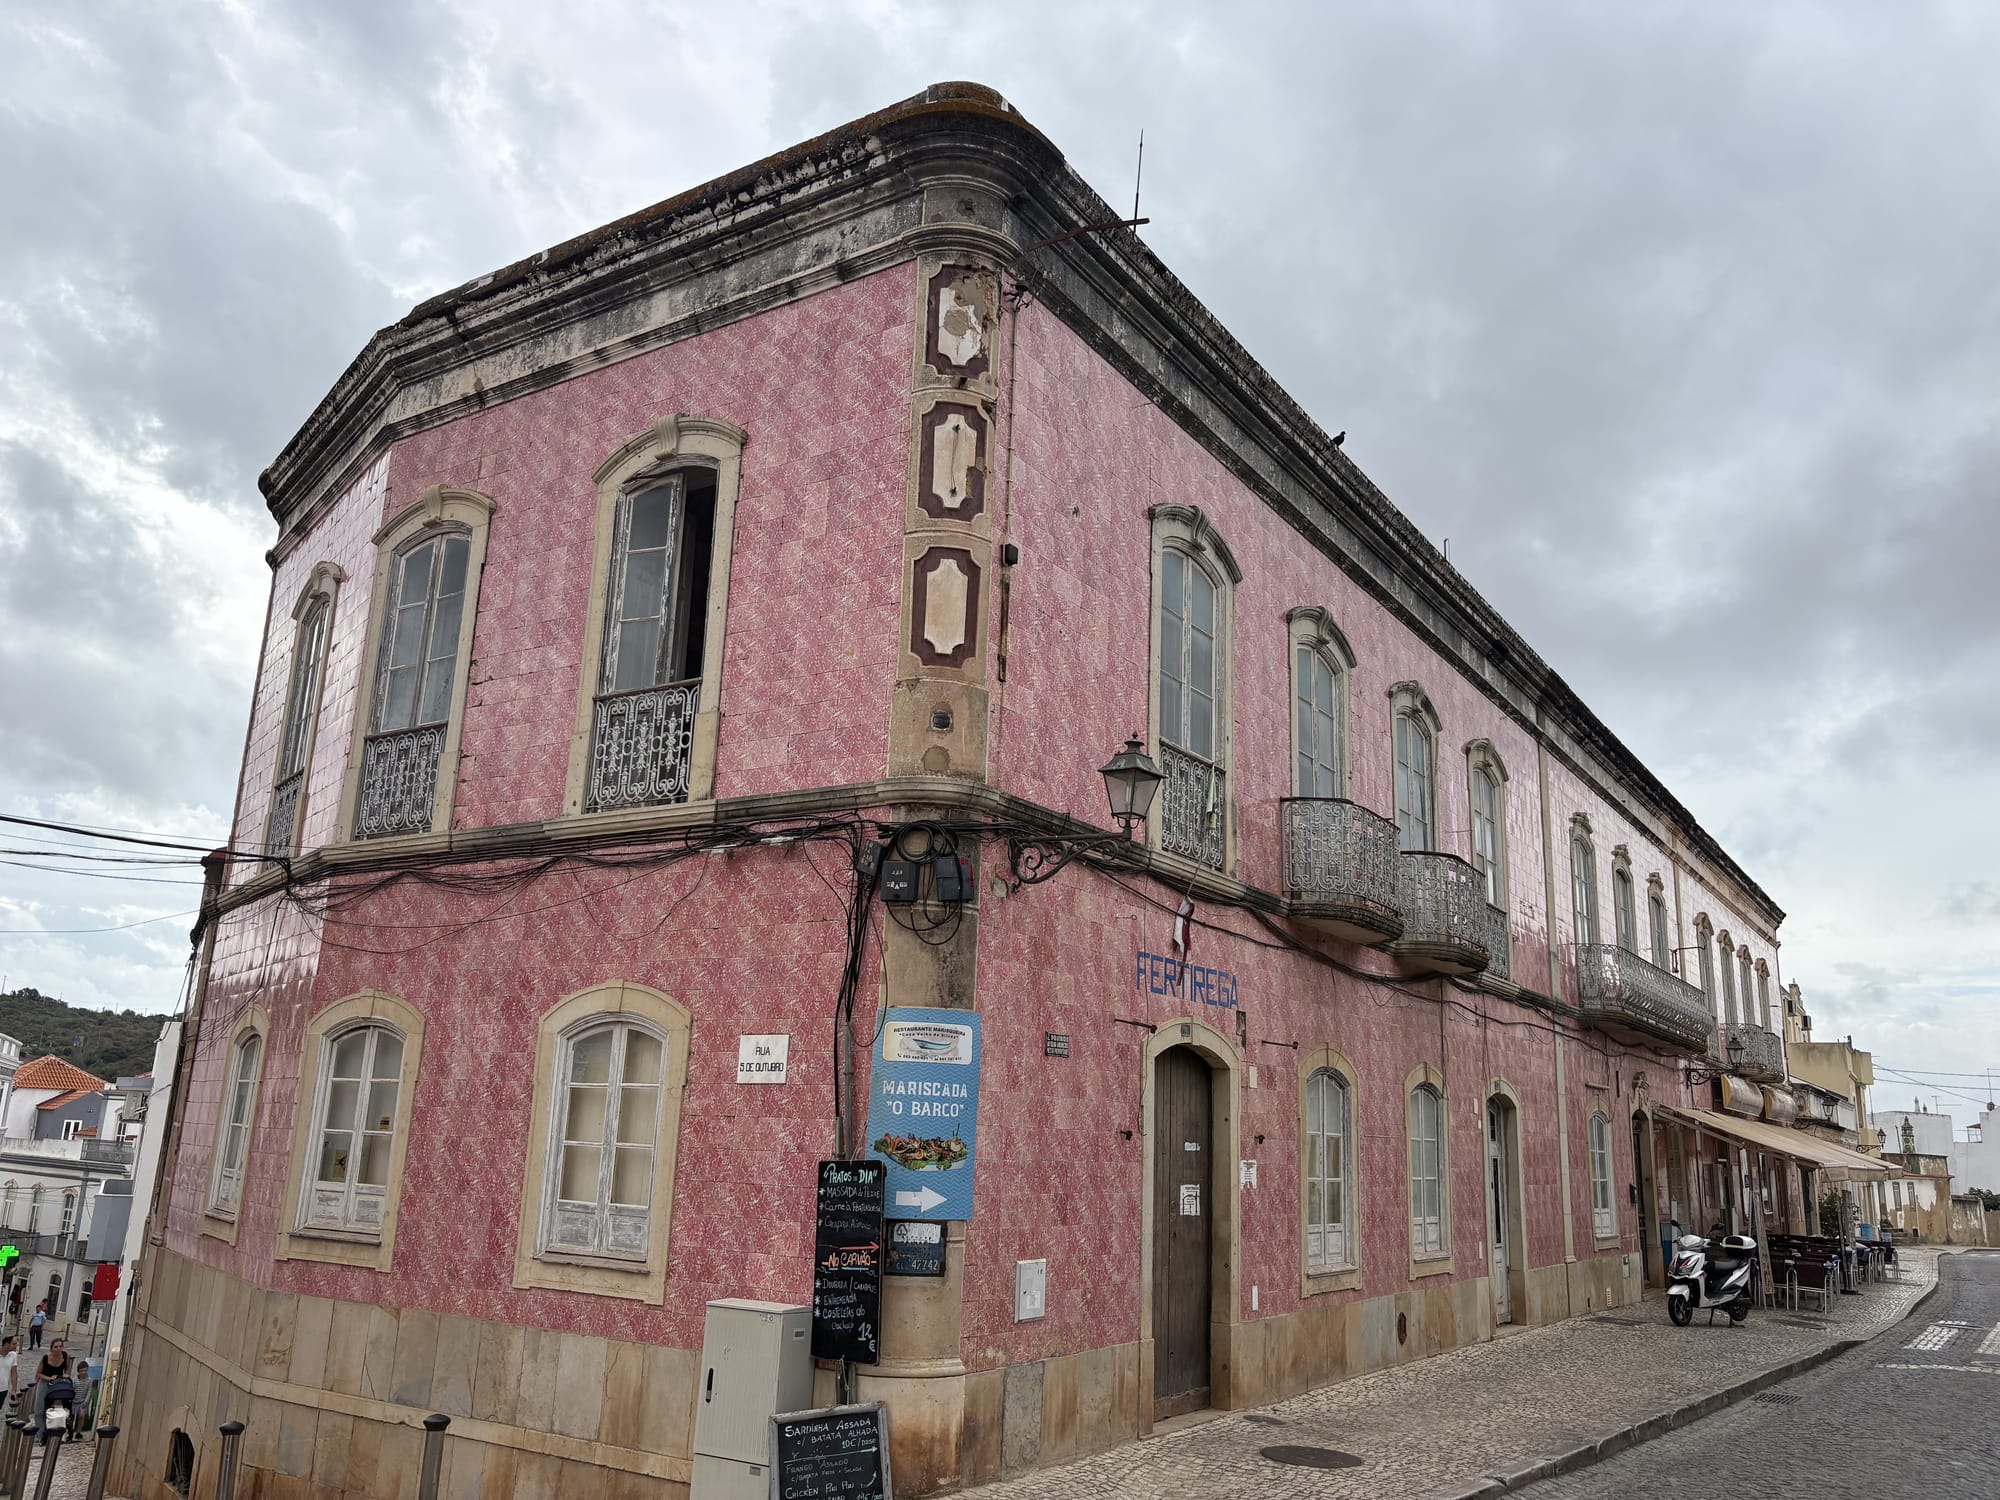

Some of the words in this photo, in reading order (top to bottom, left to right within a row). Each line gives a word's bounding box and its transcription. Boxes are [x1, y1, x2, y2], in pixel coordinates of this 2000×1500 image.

[1136, 951, 1239, 1009] FERTIREGA
[933, 1027, 966, 1037] MARISQUEIRA
[755, 1046, 771, 1056] RUA
[740, 1062, 745, 1072] 5
[746, 1062, 755, 1072] DE
[755, 1062, 785, 1072] OUTUBRO
[882, 1080, 968, 1098] MARISCADA
[911, 1101, 965, 1117] BARCO"
[857, 1322, 873, 1341] 12
[785, 1422, 830, 1437] SARDINHA
[836, 1417, 871, 1430] ASSADA
[811, 1431, 842, 1444] BATATA
[848, 1425, 879, 1437] ALHADA
[784, 1487, 819, 1500] CHICKEN
